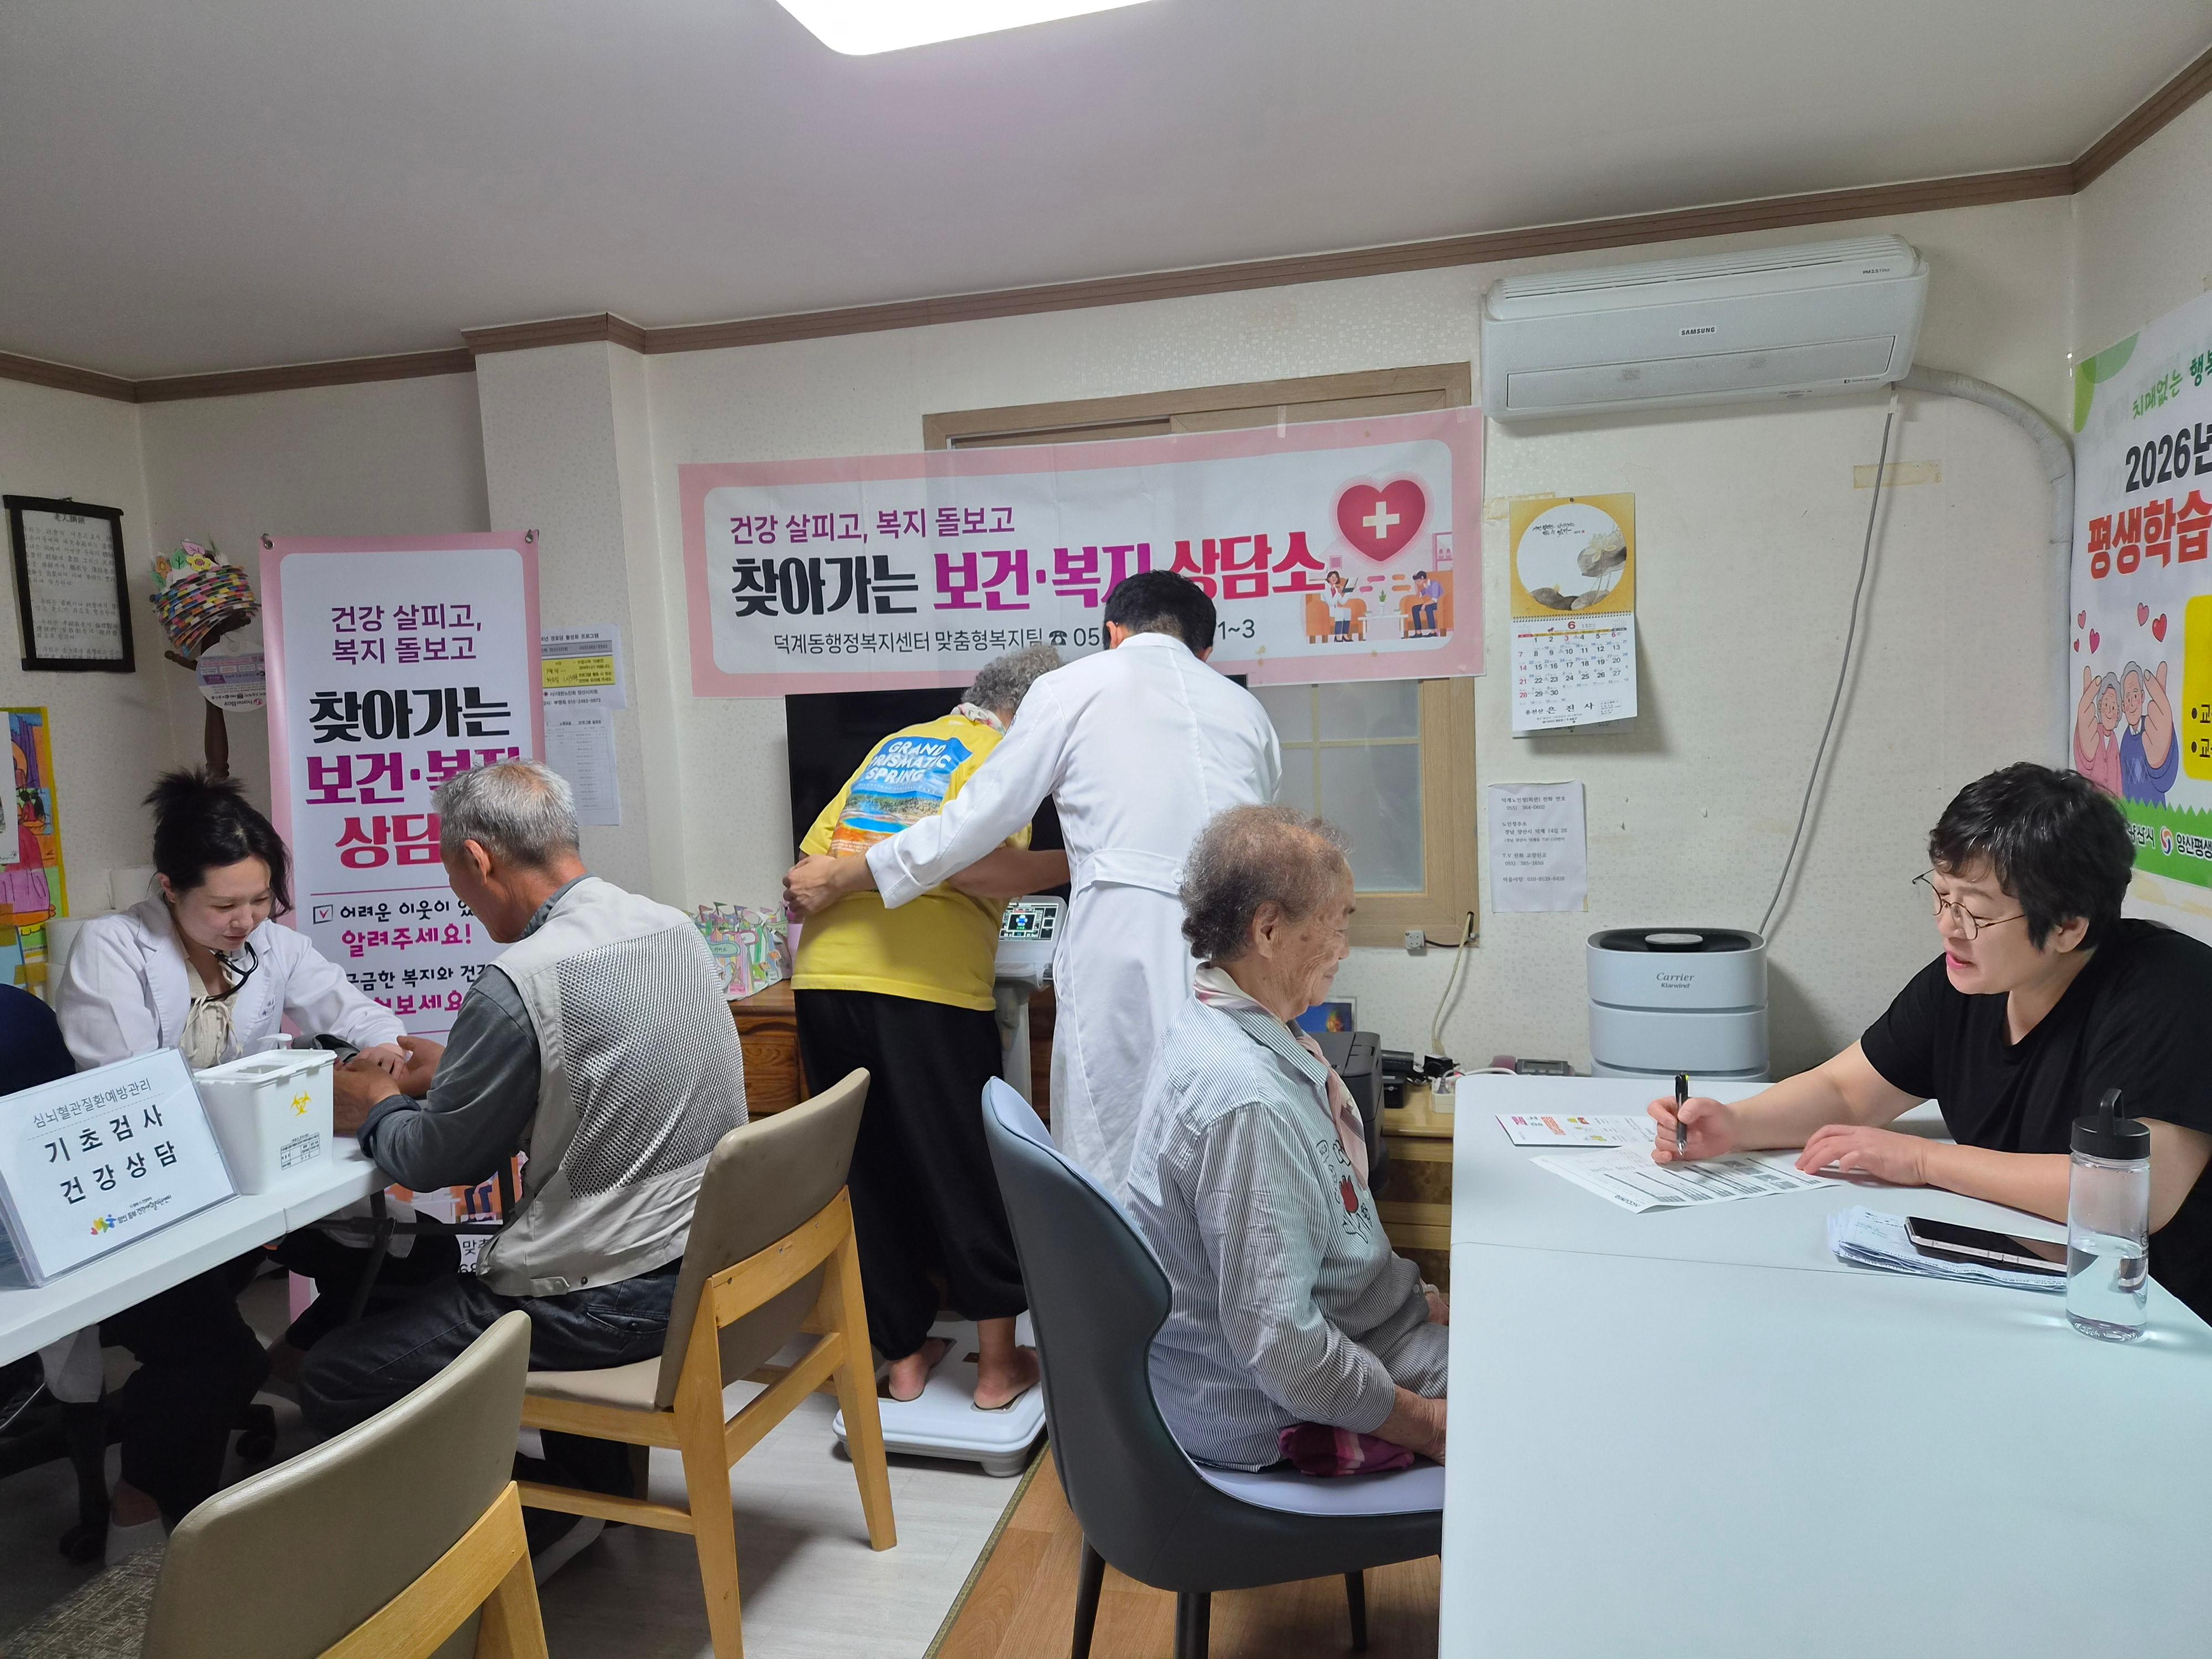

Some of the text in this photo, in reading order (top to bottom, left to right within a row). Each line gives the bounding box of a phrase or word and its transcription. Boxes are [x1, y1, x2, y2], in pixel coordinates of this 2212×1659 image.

[1681, 327, 1716, 336] SAMSUNG
[2132, 369, 2183, 420] 치매없는
[730, 507, 1015, 544] 건강 살피고, 복지 돌보고
[2087, 489, 2212, 580] 평생학습
[731, 555, 919, 618] 찾아가는
[332, 603, 482, 633] 건강 살피고,
[1567, 620, 1576, 630] 6
[333, 637, 477, 665] 복지 돌보고
[774, 620, 1256, 655] 덕계동행정복지센터 맞춤형복지팀 05 1~3
[309, 687, 511, 744] 찾아가는
[2200, 704, 2212, 724] 교
[888, 741, 947, 757] GRAND
[2199, 738, 2212, 758] 교
[865, 766, 926, 784] SPRING
[335, 813, 443, 869] 상담
[340, 903, 392, 922] 어려운
[399, 900, 450, 920] 이웃이
[342, 923, 472, 957] 알려주세요!
[401, 966, 453, 988] 복지와
[1656, 972, 1694, 982] Carrier
[32, 1078, 152, 1129] 심뇌혈관질환예방관리
[44, 1104, 164, 1164] 기초검사
[60, 1140, 178, 1205] 건강상담
